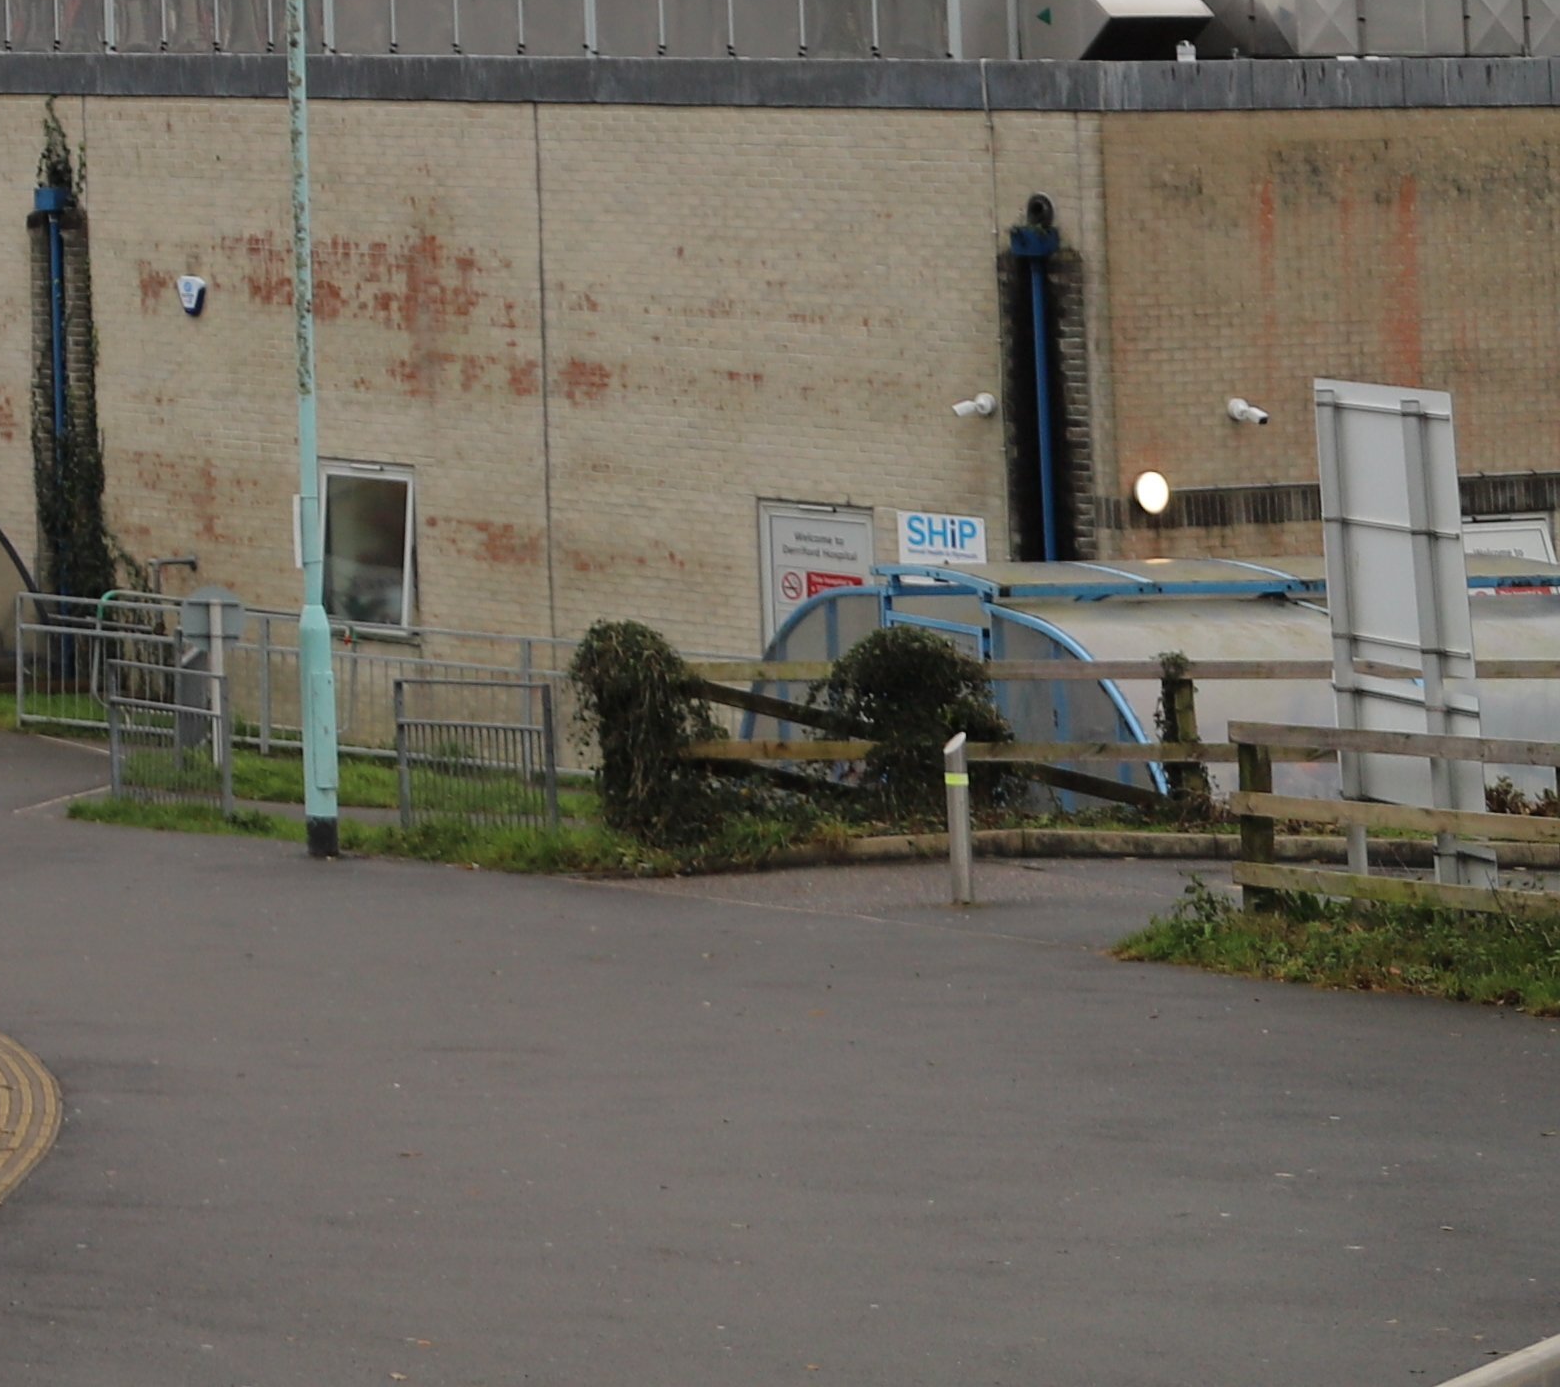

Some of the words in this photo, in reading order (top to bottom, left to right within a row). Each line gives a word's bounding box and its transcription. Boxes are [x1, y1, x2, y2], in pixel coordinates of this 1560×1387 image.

[794, 532, 832, 545] Welcome
[834, 537, 844, 546] to
[907, 514, 977, 549] SHiP
[782, 544, 821, 557] Derriford
[822, 548, 857, 561] Hospital
